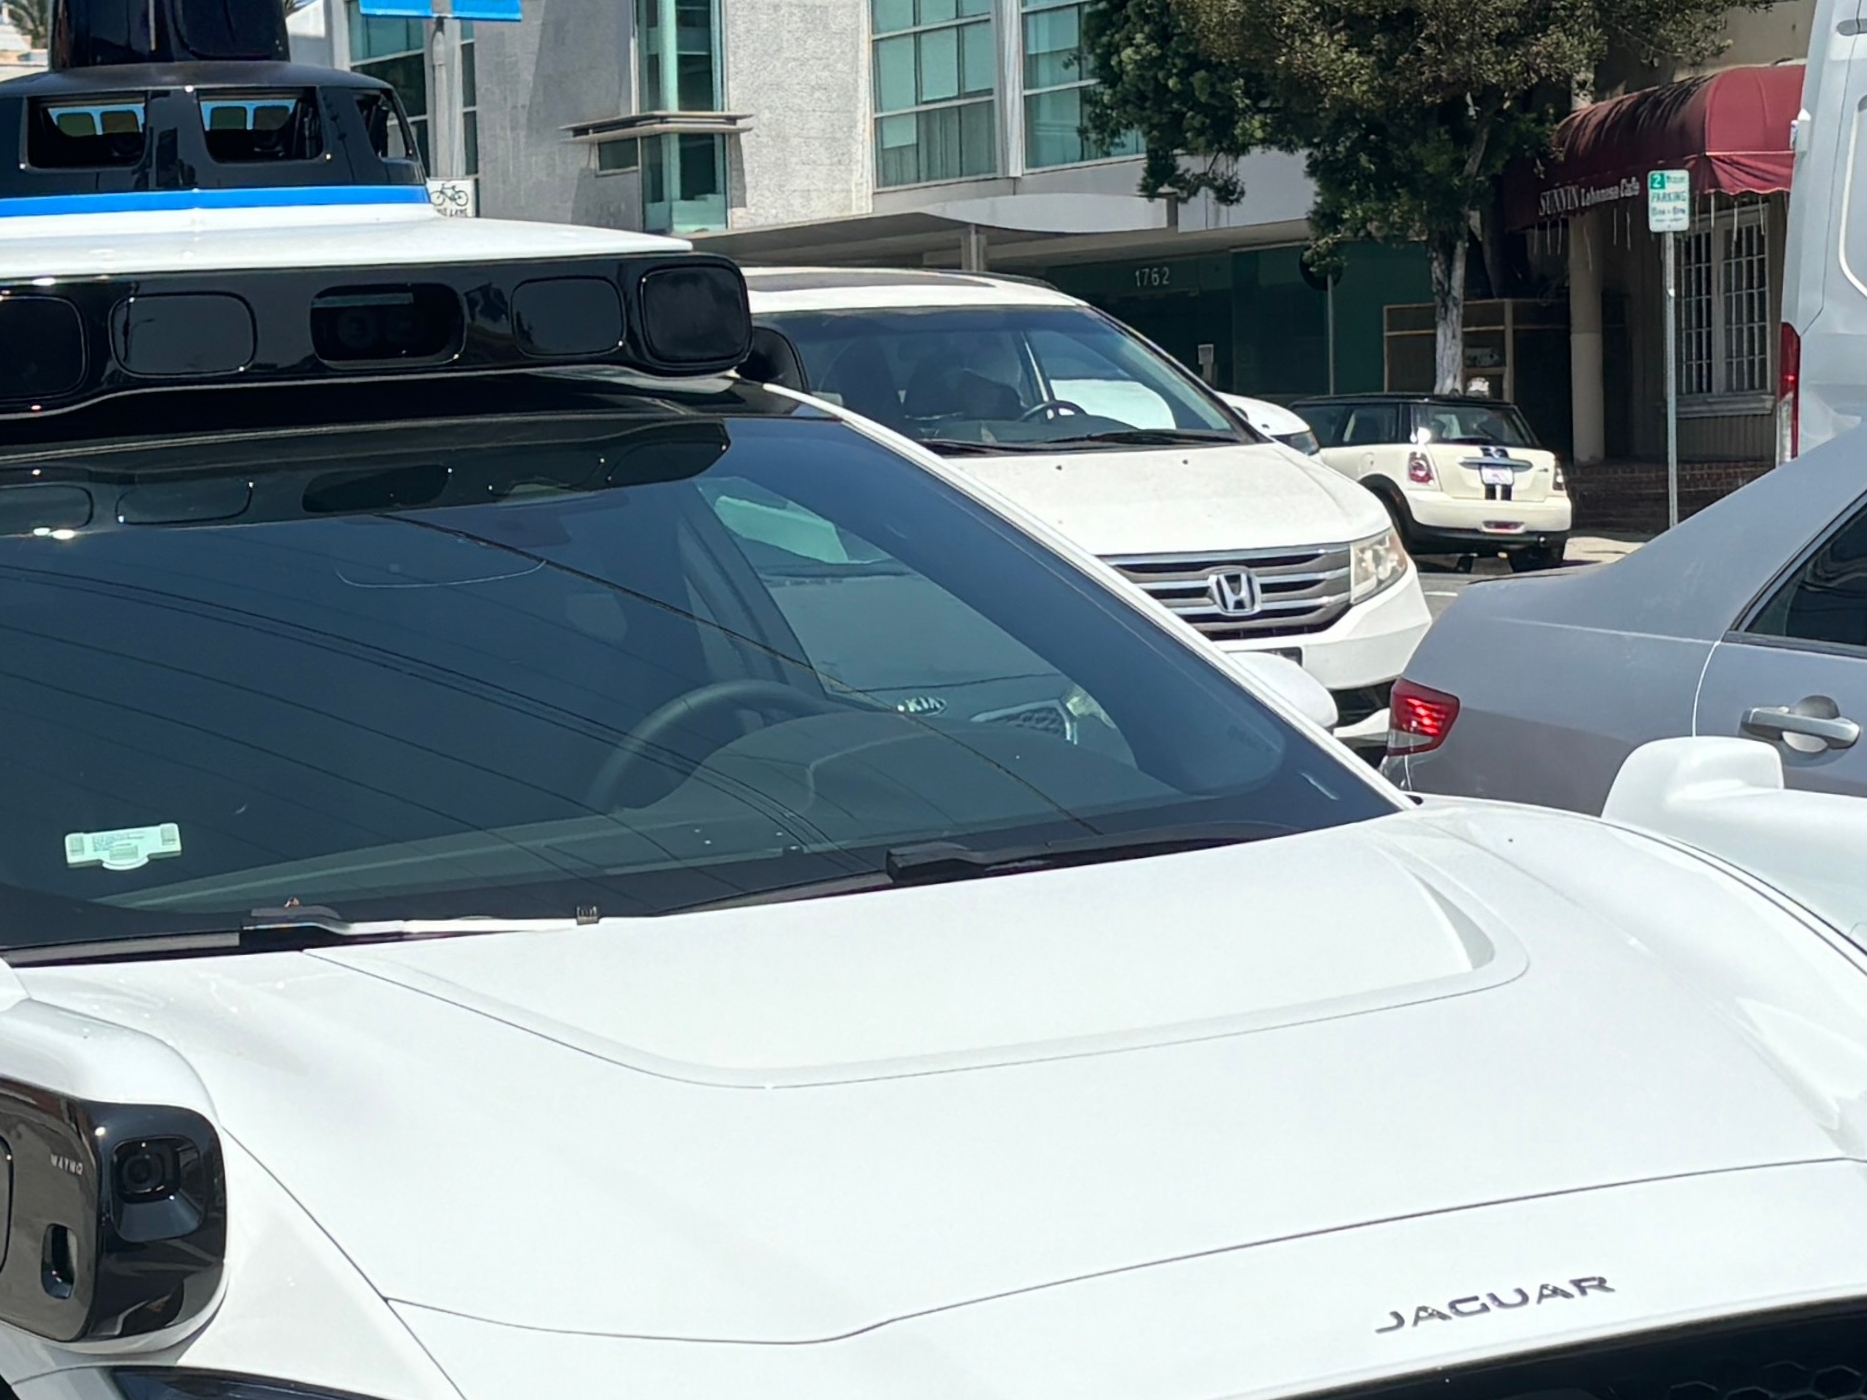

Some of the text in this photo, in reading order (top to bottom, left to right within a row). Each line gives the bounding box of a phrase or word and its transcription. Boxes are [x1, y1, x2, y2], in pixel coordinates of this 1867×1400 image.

[1620, 176, 1641, 198] Cafe
[1652, 173, 1661, 188] 2
[1135, 266, 1170, 287] 1762
[904, 696, 941, 712] KIA
[49, 1153, 84, 1176] WAYMO
[1374, 1275, 1616, 1334] JAGUAR
